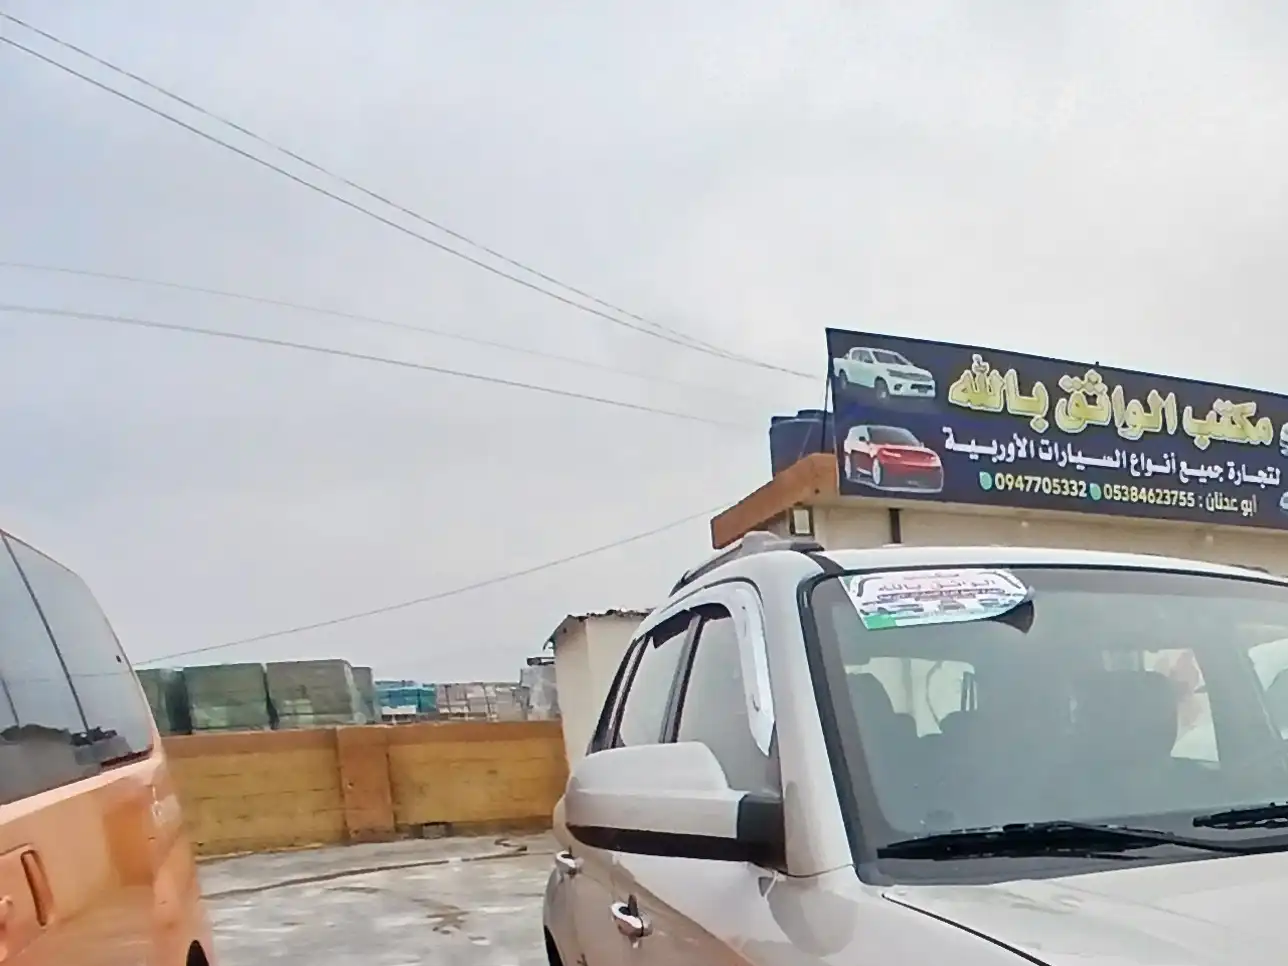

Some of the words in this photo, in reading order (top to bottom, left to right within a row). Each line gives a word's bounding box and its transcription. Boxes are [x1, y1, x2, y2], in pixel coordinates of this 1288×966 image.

[948, 353, 1050, 433] بالله
[1055, 369, 1178, 441] الواثق
[1182, 398, 1274, 450] مكتب
[1038, 438, 1127, 471] السيارات
[1130, 452, 1177, 477] أنواع
[994, 472, 1088, 498] 0947705332
[1179, 460, 1224, 484] جميع
[1227, 461, 1281, 489] لتجارة
[1103, 483, 1196, 508] 05384623755
[1205, 491, 1239, 512] عدنان
